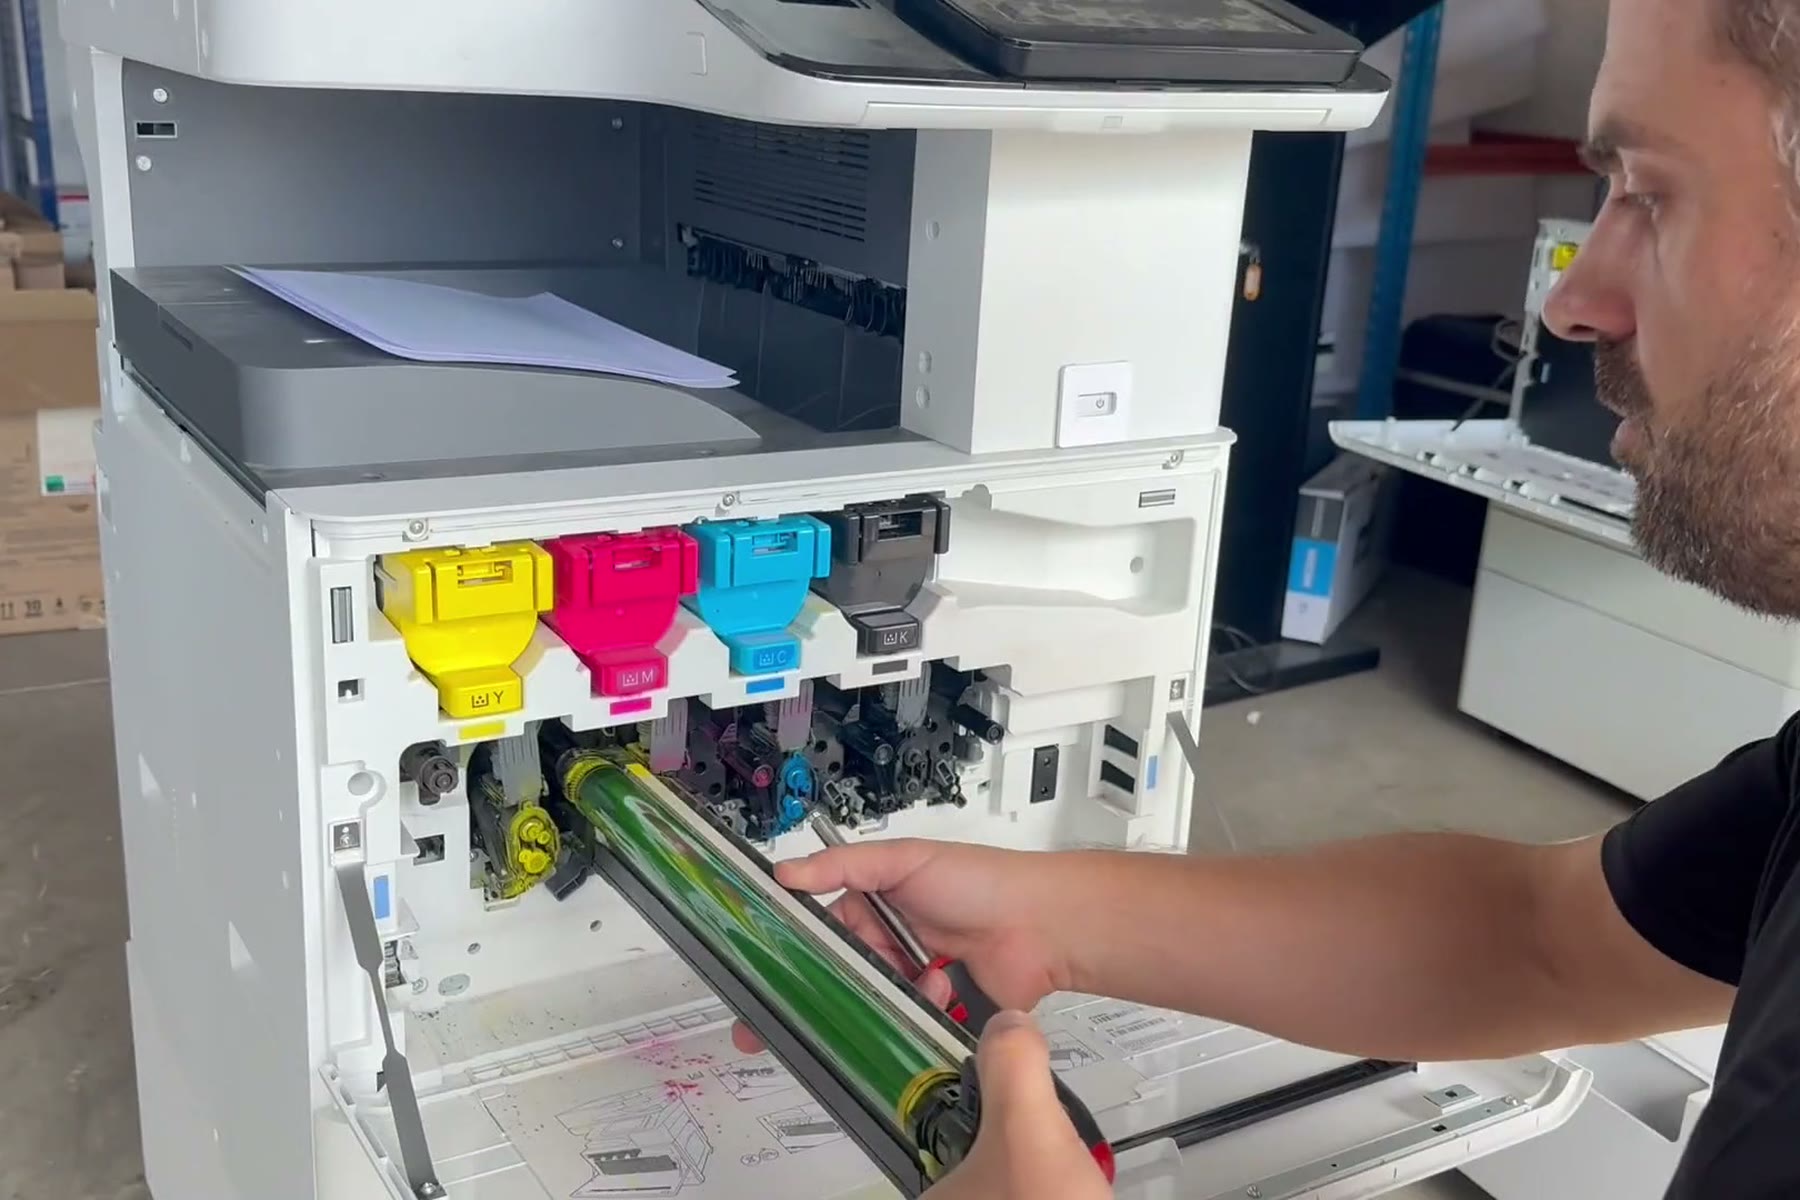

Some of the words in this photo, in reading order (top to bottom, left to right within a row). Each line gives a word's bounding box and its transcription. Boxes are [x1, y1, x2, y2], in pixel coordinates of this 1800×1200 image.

[899, 630, 908, 644] K
[776, 650, 787, 665] C
[641, 669, 654, 684] M
[493, 690, 504, 704] Y
